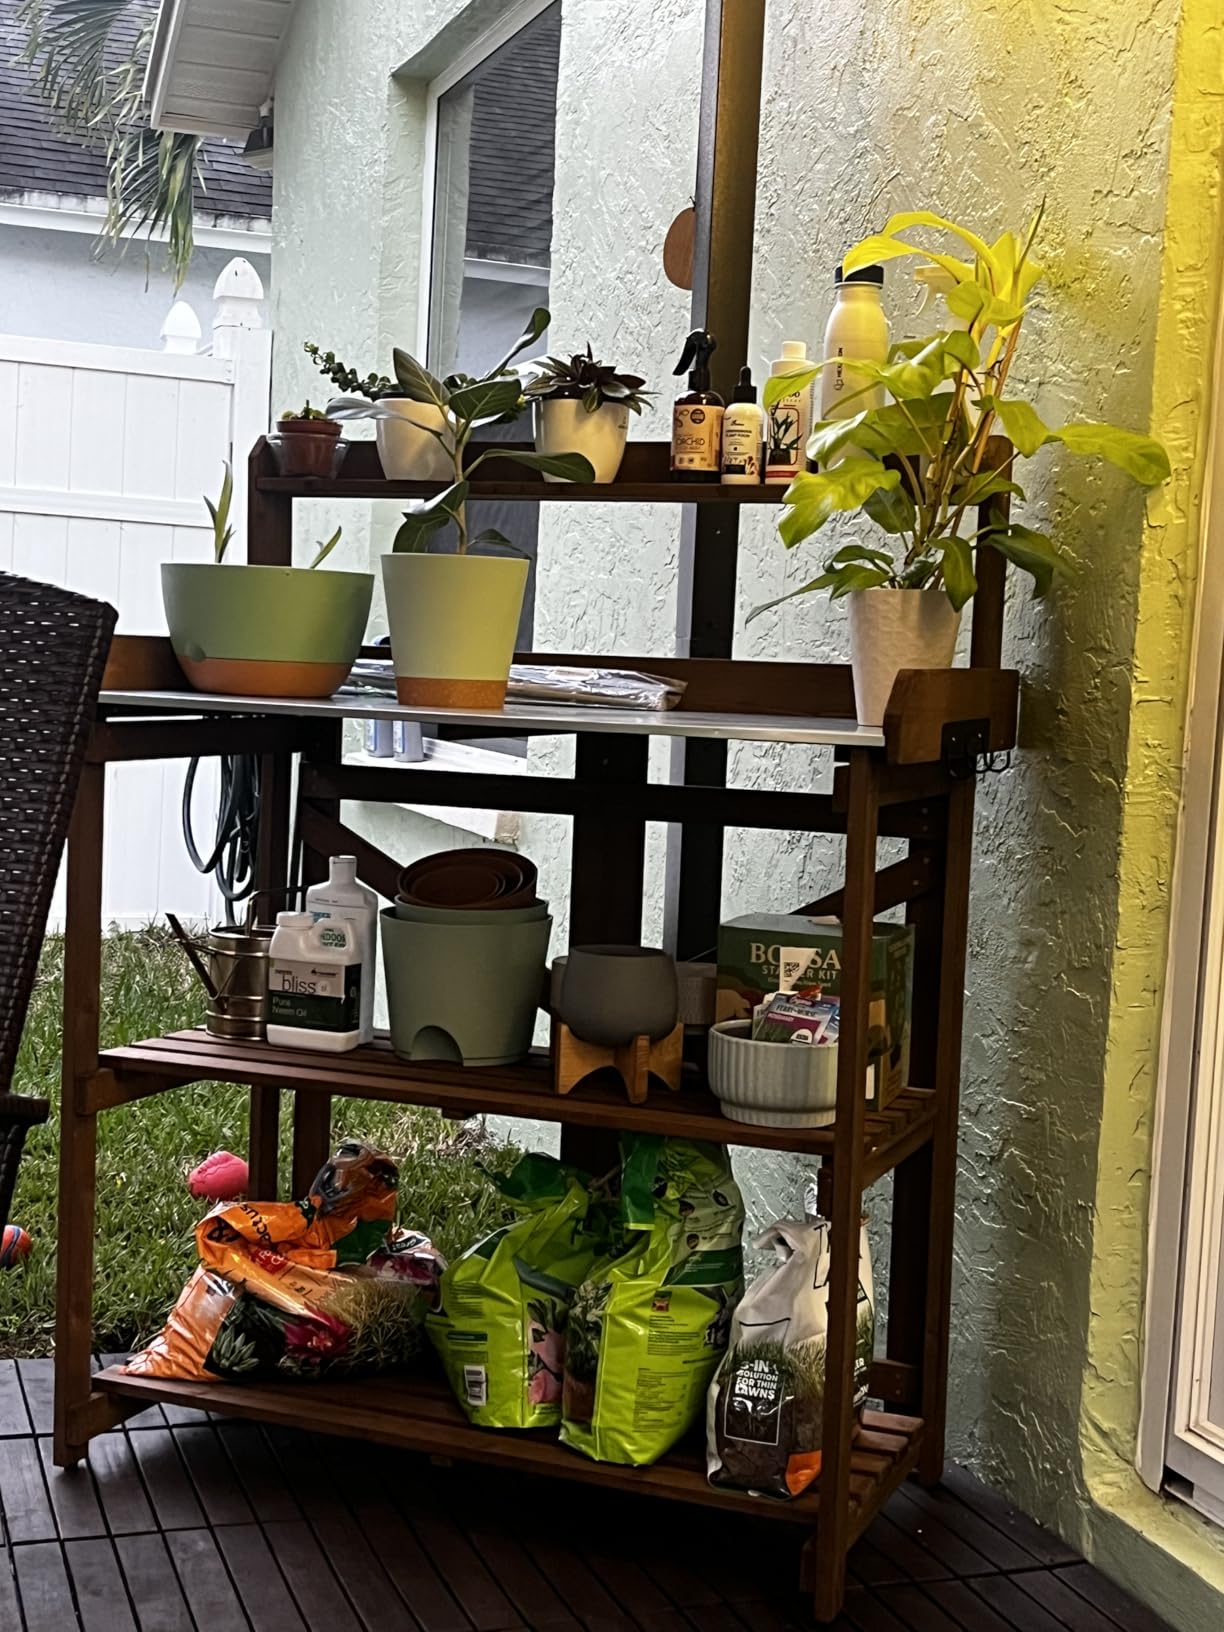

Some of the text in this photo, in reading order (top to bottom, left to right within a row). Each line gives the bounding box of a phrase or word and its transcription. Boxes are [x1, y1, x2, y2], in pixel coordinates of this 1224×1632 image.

[676, 437, 705, 446] ORCHID
[819, 968, 838, 981] KIT
[282, 974, 316, 993] bliss
[240, 1204, 272, 1243] actus
[736, 1369, 779, 1382] SOLUTION
[736, 1377, 777, 1390] FOR THIN
[735, 1383, 775, 1399] LAWNS
